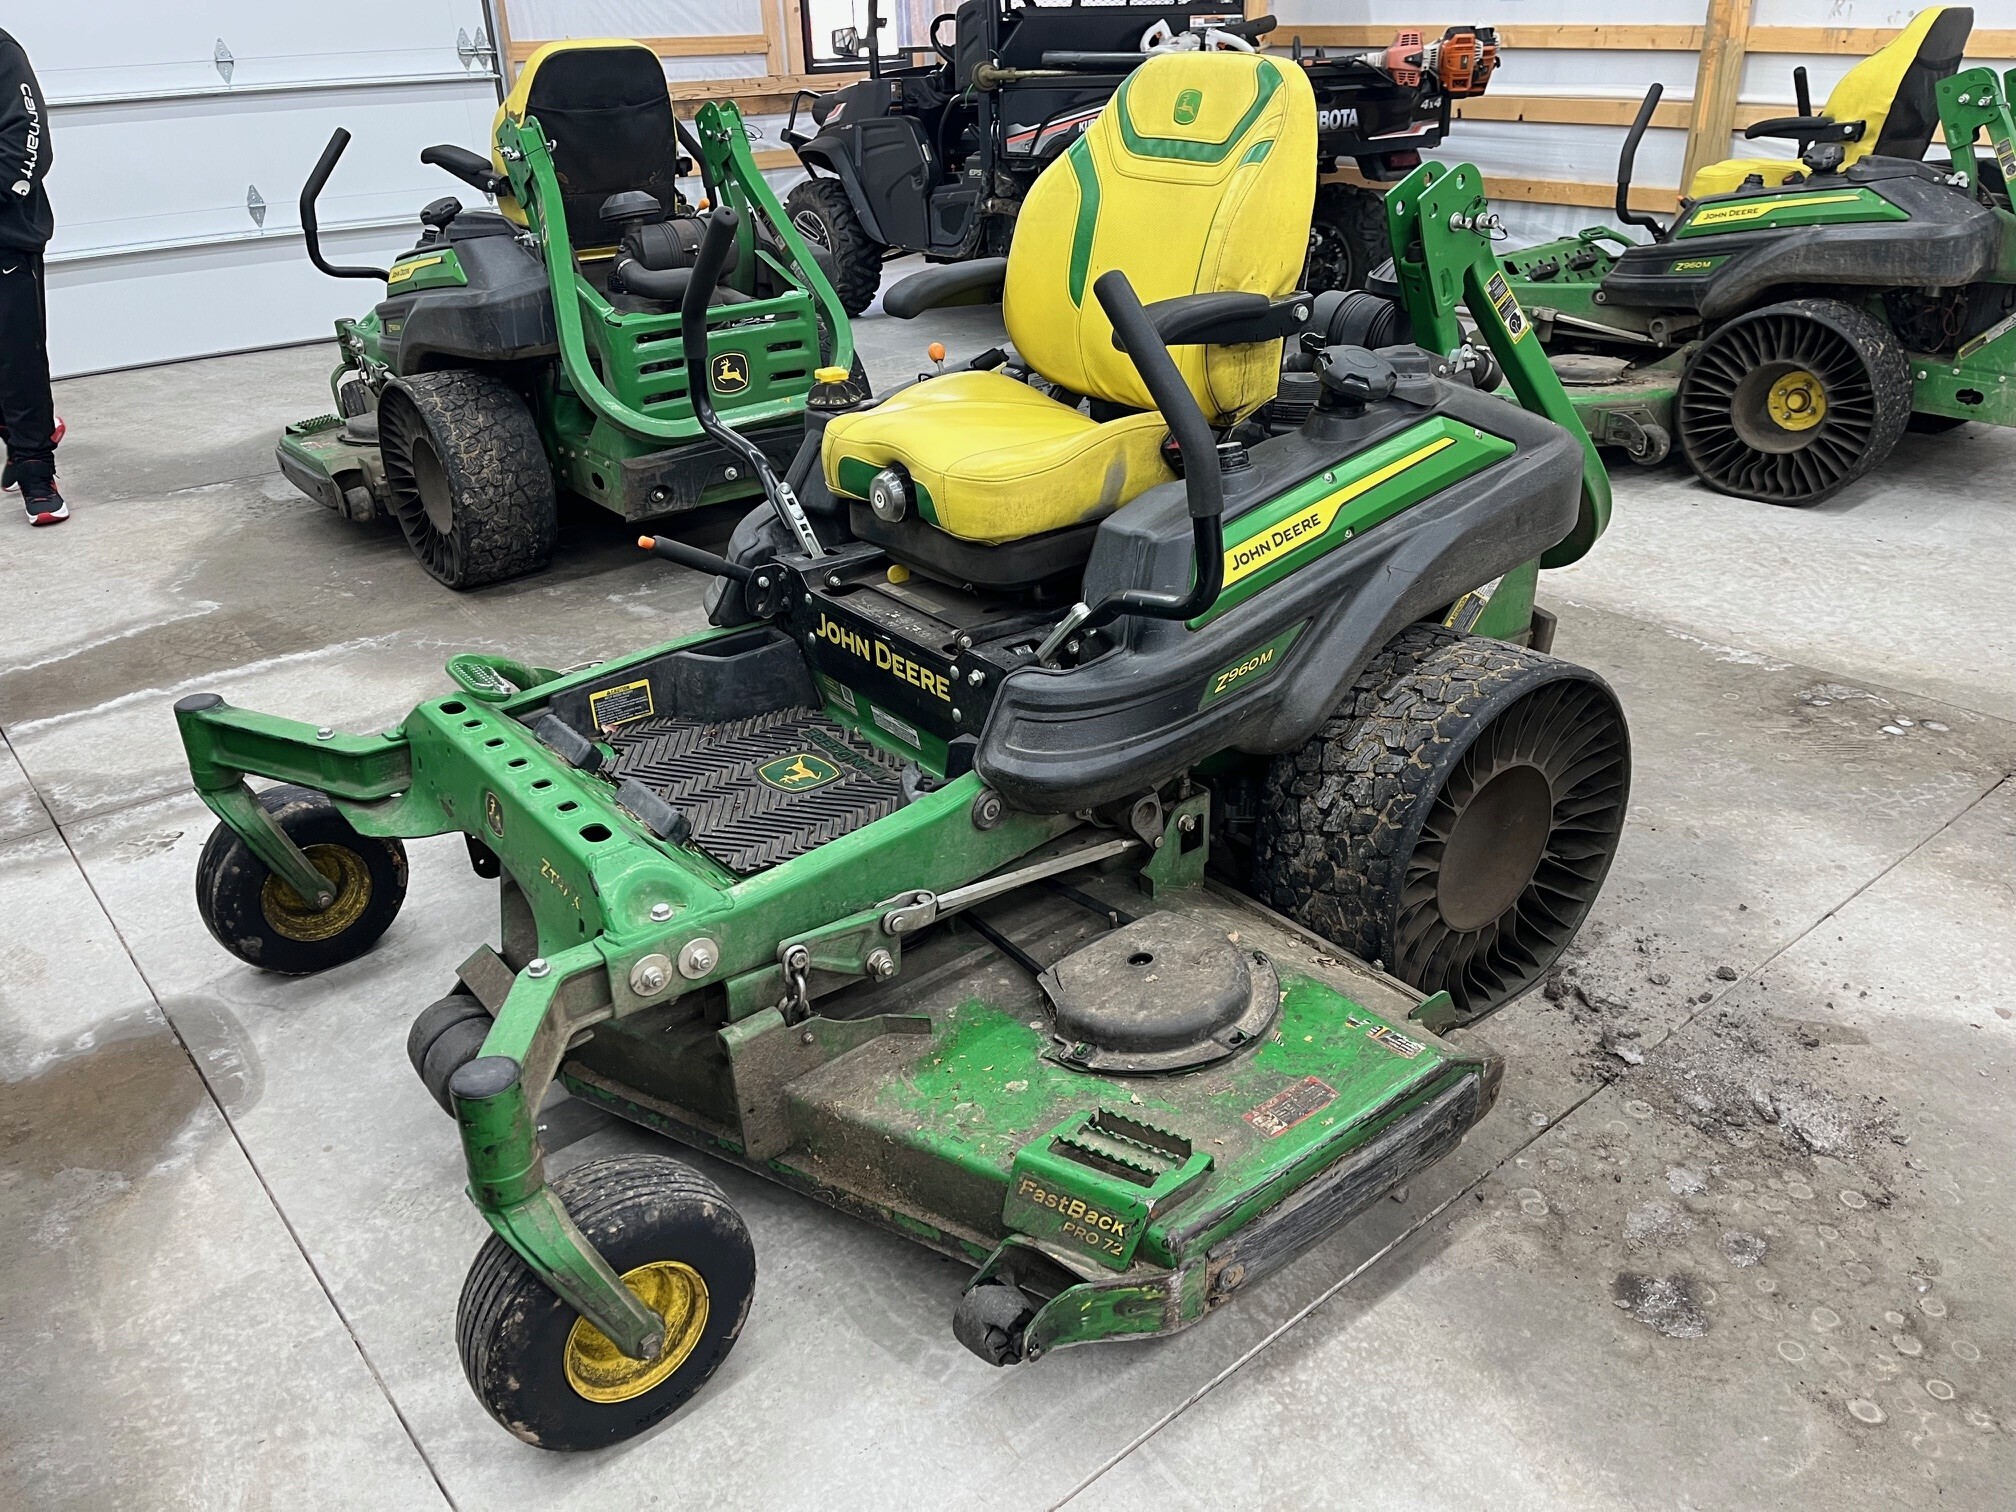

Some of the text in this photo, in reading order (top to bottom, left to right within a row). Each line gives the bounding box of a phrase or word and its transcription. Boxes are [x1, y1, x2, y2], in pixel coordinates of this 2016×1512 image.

[1317, 108, 1359, 130] BOTA
[1420, 98, 1442, 109] 4x4
[20, 83, 40, 179] carhartt
[1703, 207, 1759, 220] JOHN DEERE
[1675, 261, 1711, 271] Z960M
[1232, 513, 1321, 571] JOHN DEERE
[816, 612, 871, 662] JOHN
[874, 640, 951, 703] DEERE
[1214, 648, 1274, 693] Z960M
[1018, 1179, 1125, 1237] FastBack
[1062, 1221, 1123, 1256] PRO 72
